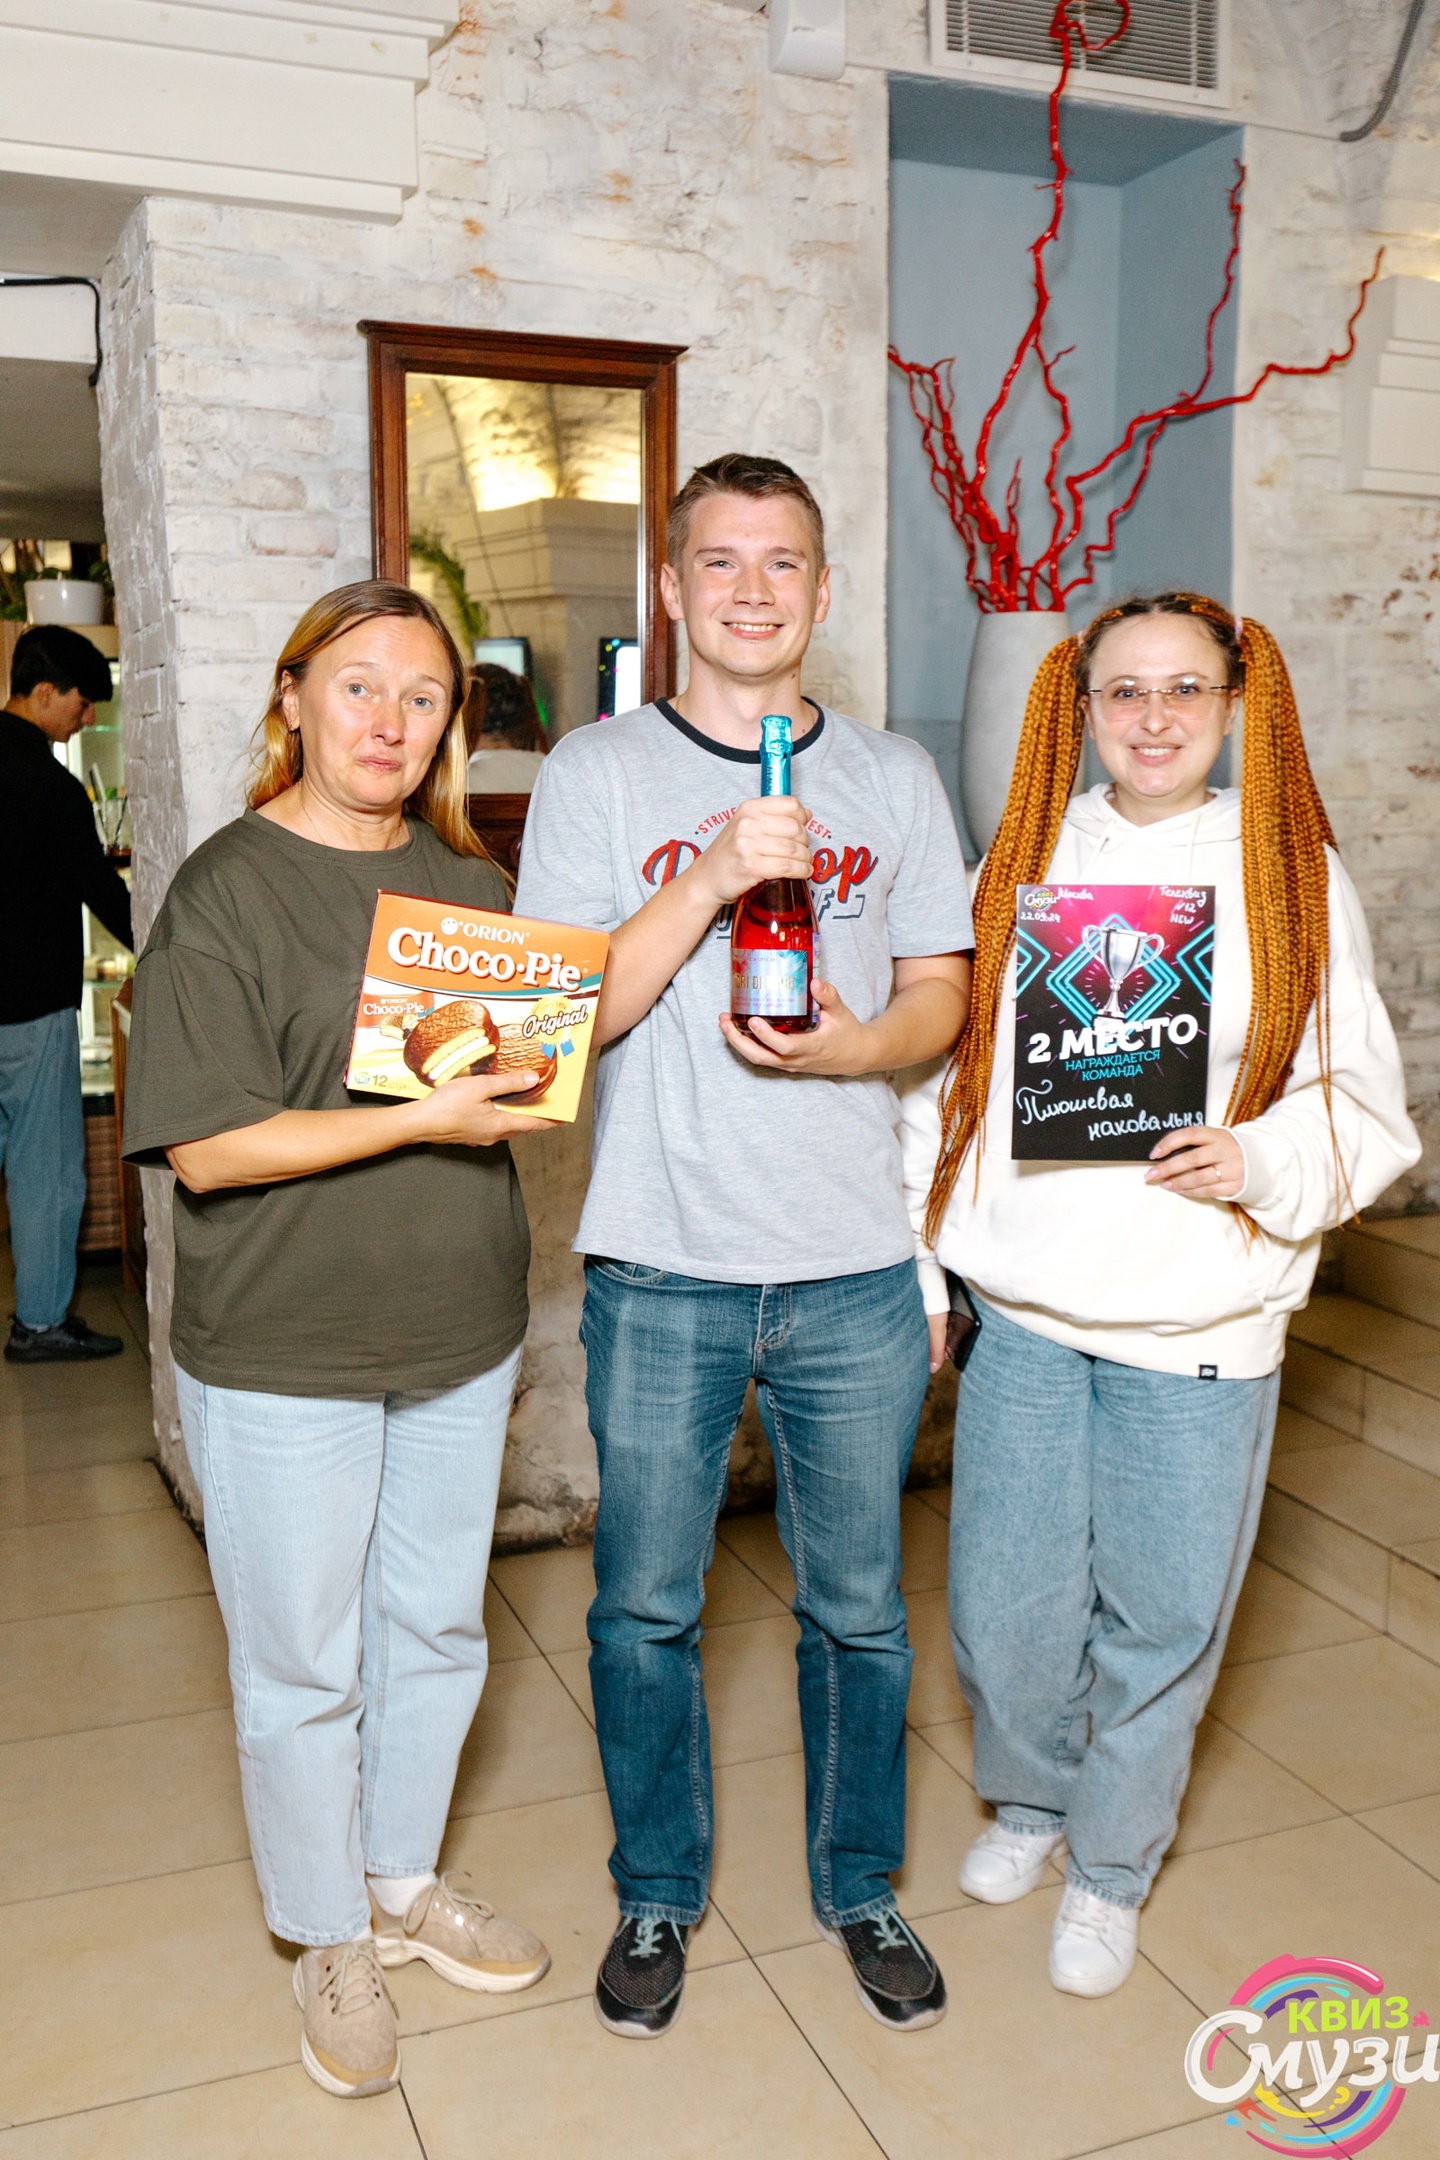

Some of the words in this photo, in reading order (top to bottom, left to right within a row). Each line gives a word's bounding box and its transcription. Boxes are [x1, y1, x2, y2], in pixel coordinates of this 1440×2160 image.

[462, 922, 525, 946] ORION
[522, 1004, 589, 1038] Original
[1028, 1032, 1052, 1064] 2
[1059, 1013, 1198, 1061] МЕСТО
[1065, 1049, 1161, 1071] НАГРАЖДАЕТСЯ
[1082, 1064, 1143, 1081] КОМАНДА
[373, 1074, 388, 1088] 12
[1016, 1079, 1134, 1125] Плюшевая
[1088, 1109, 1204, 1142] наковальня
